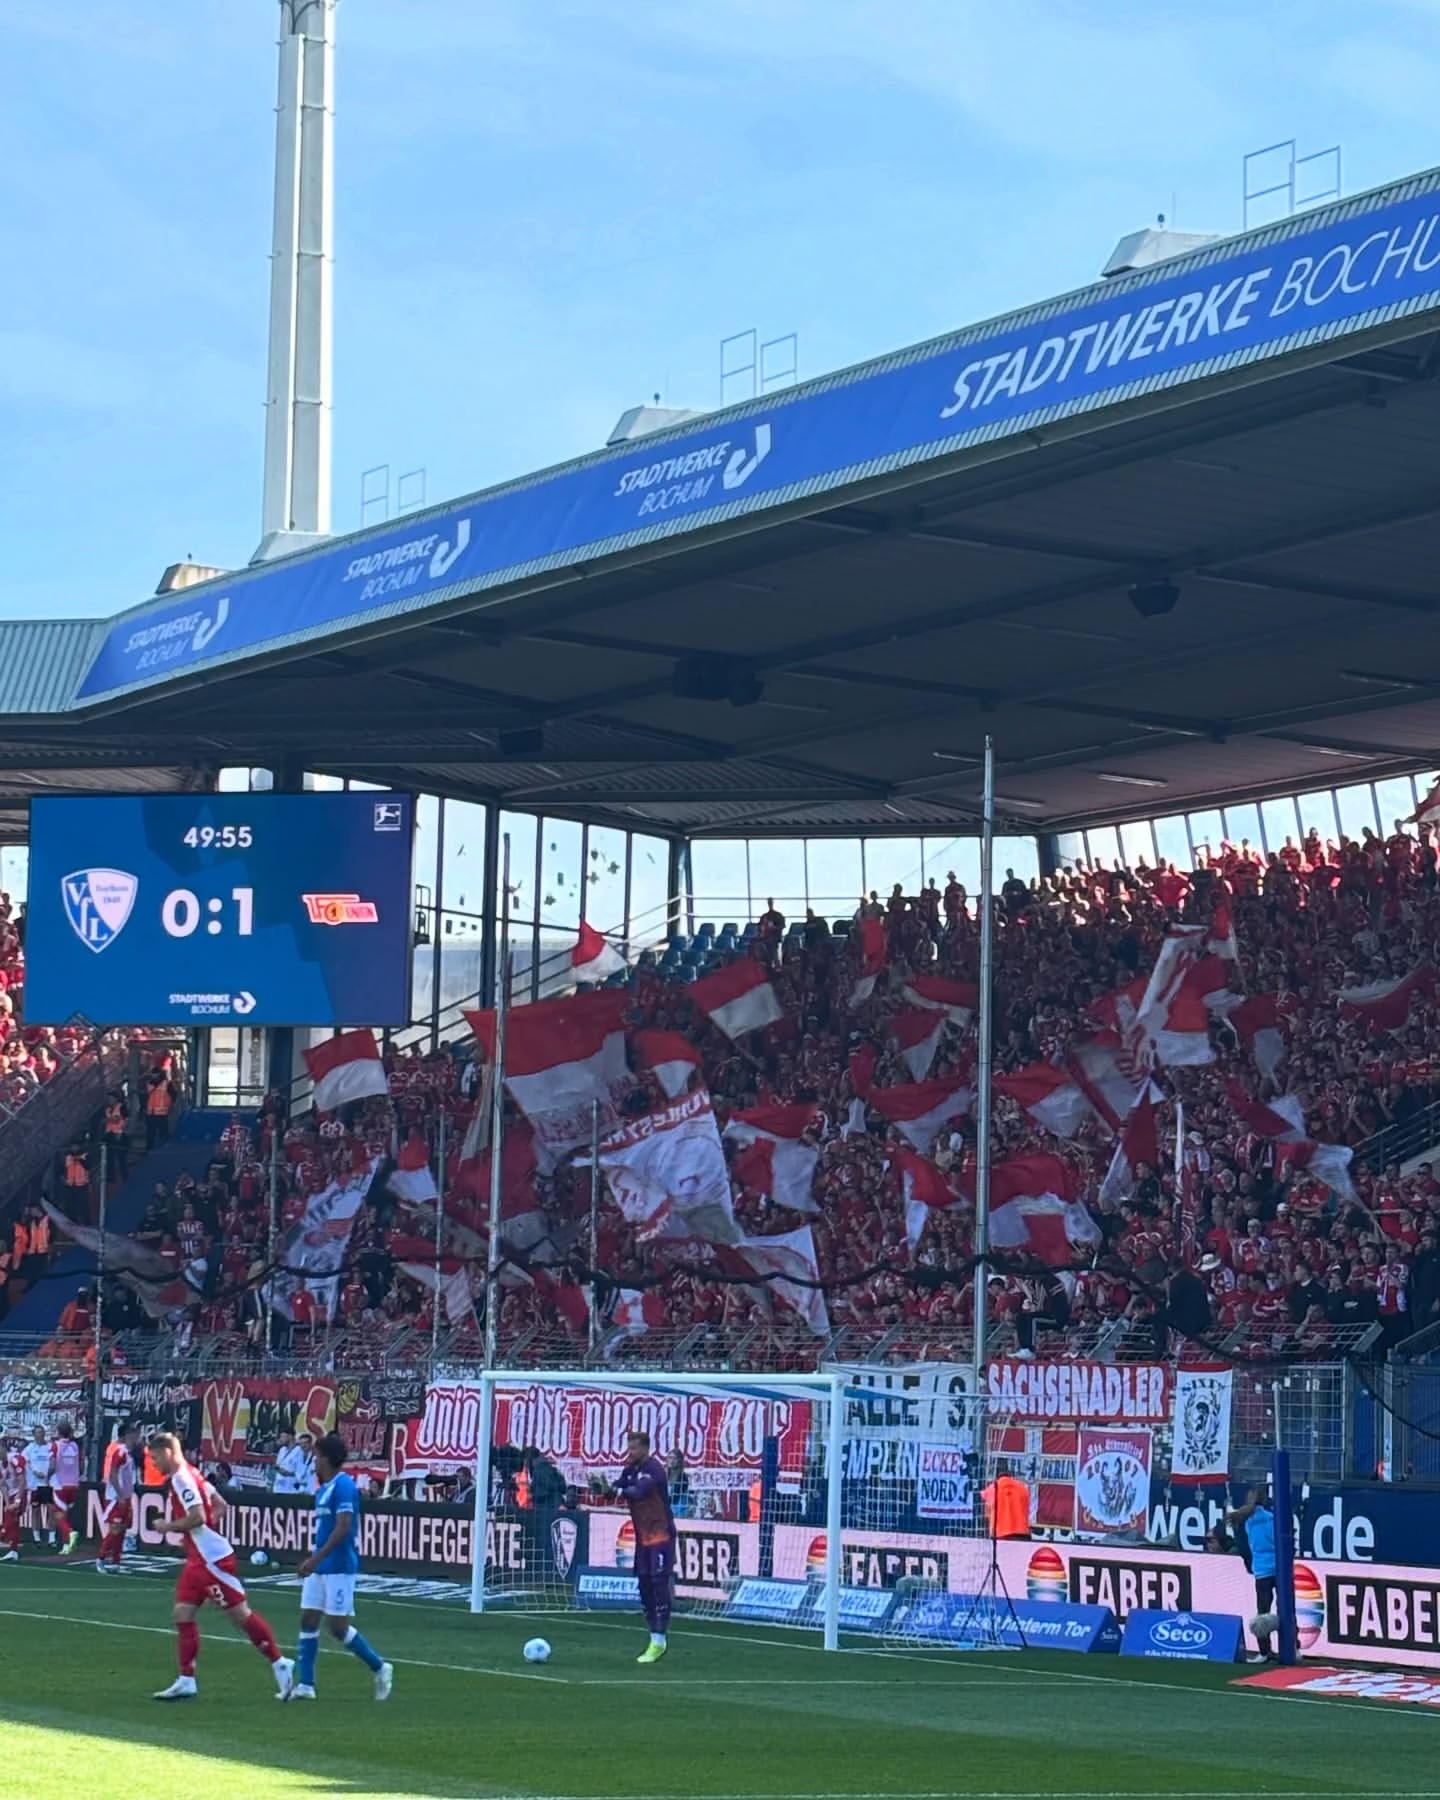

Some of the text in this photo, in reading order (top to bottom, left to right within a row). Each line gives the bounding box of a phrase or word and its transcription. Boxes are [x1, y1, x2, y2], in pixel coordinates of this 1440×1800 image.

[940, 268, 1272, 419] STADTWERKE
[614, 441, 731, 496] STADTWERKE
[638, 474, 714, 517] BOCHUM
[343, 533, 439, 582] STADTWERKE
[360, 564, 424, 600] BOCHUM
[183, 826, 253, 848] 49:55
[162, 887, 254, 938] 0:1
[168, 993, 231, 1004] STADTWERKE
[988, 1363, 1165, 1417] SACHSENADLER
[921, 1450, 961, 1473] ECKE
[673, 1536, 732, 1583] ABER
[1079, 1565, 1180, 1616] FABER
[1065, 1620, 1092, 1638] Tor
[1155, 1623, 1207, 1643] Seco
